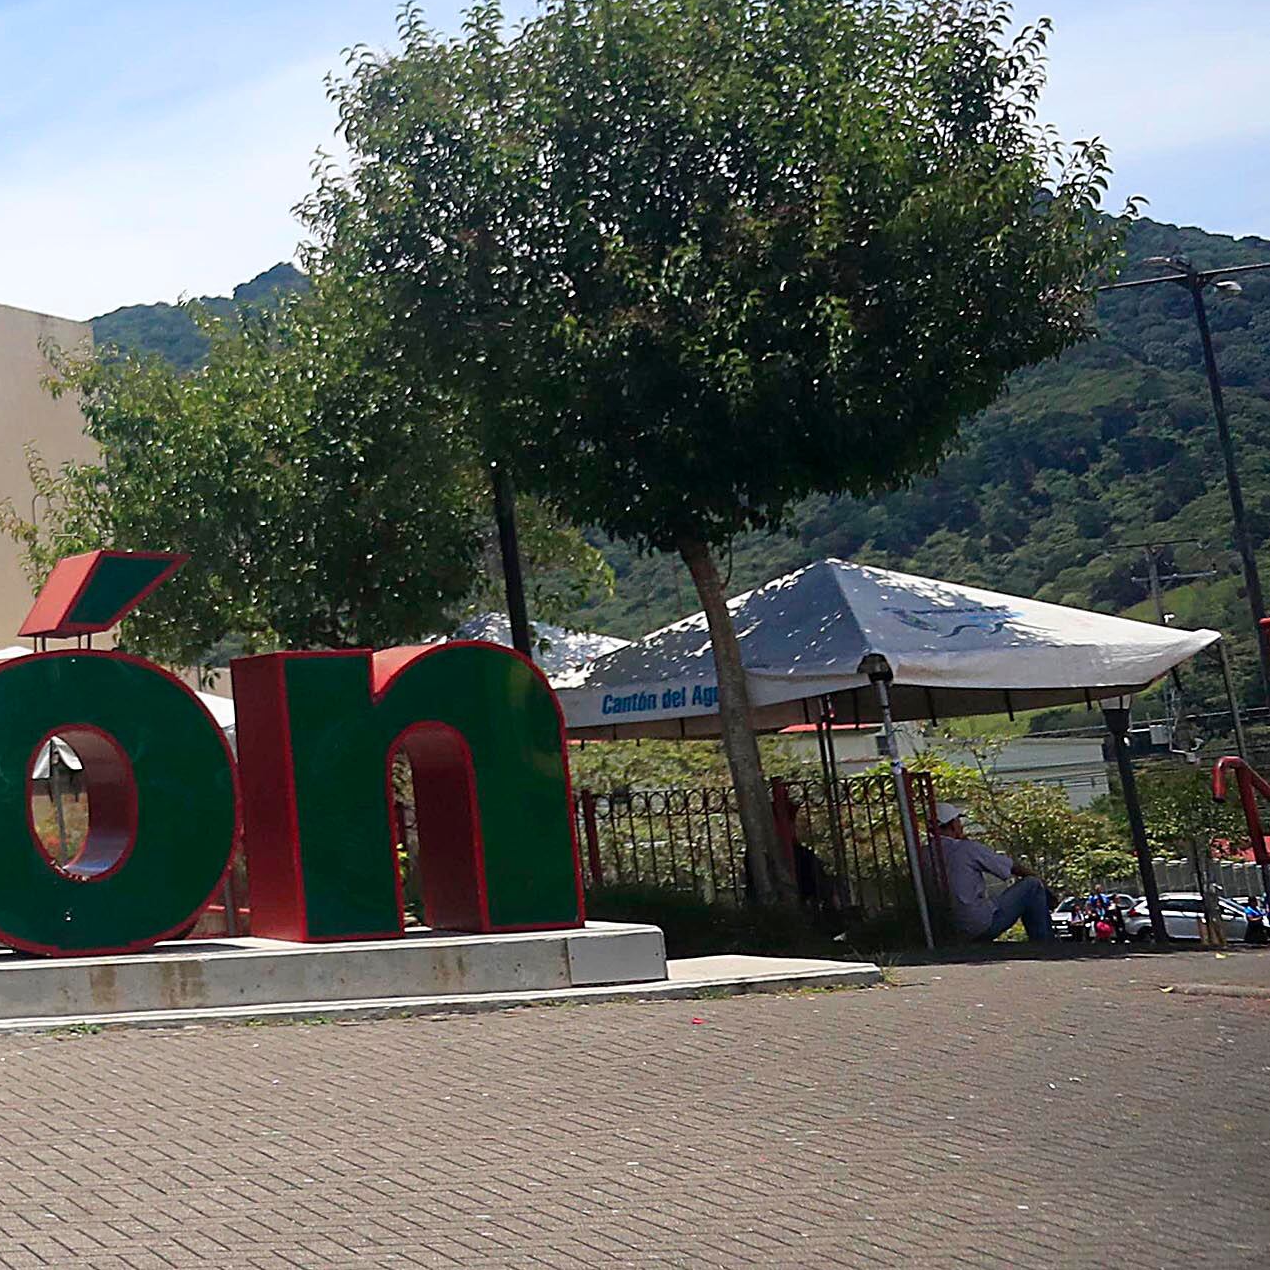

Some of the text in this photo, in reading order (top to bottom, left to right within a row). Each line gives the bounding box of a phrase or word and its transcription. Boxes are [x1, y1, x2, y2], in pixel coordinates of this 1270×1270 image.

[601, 684, 719, 714] Cantón del Agu
